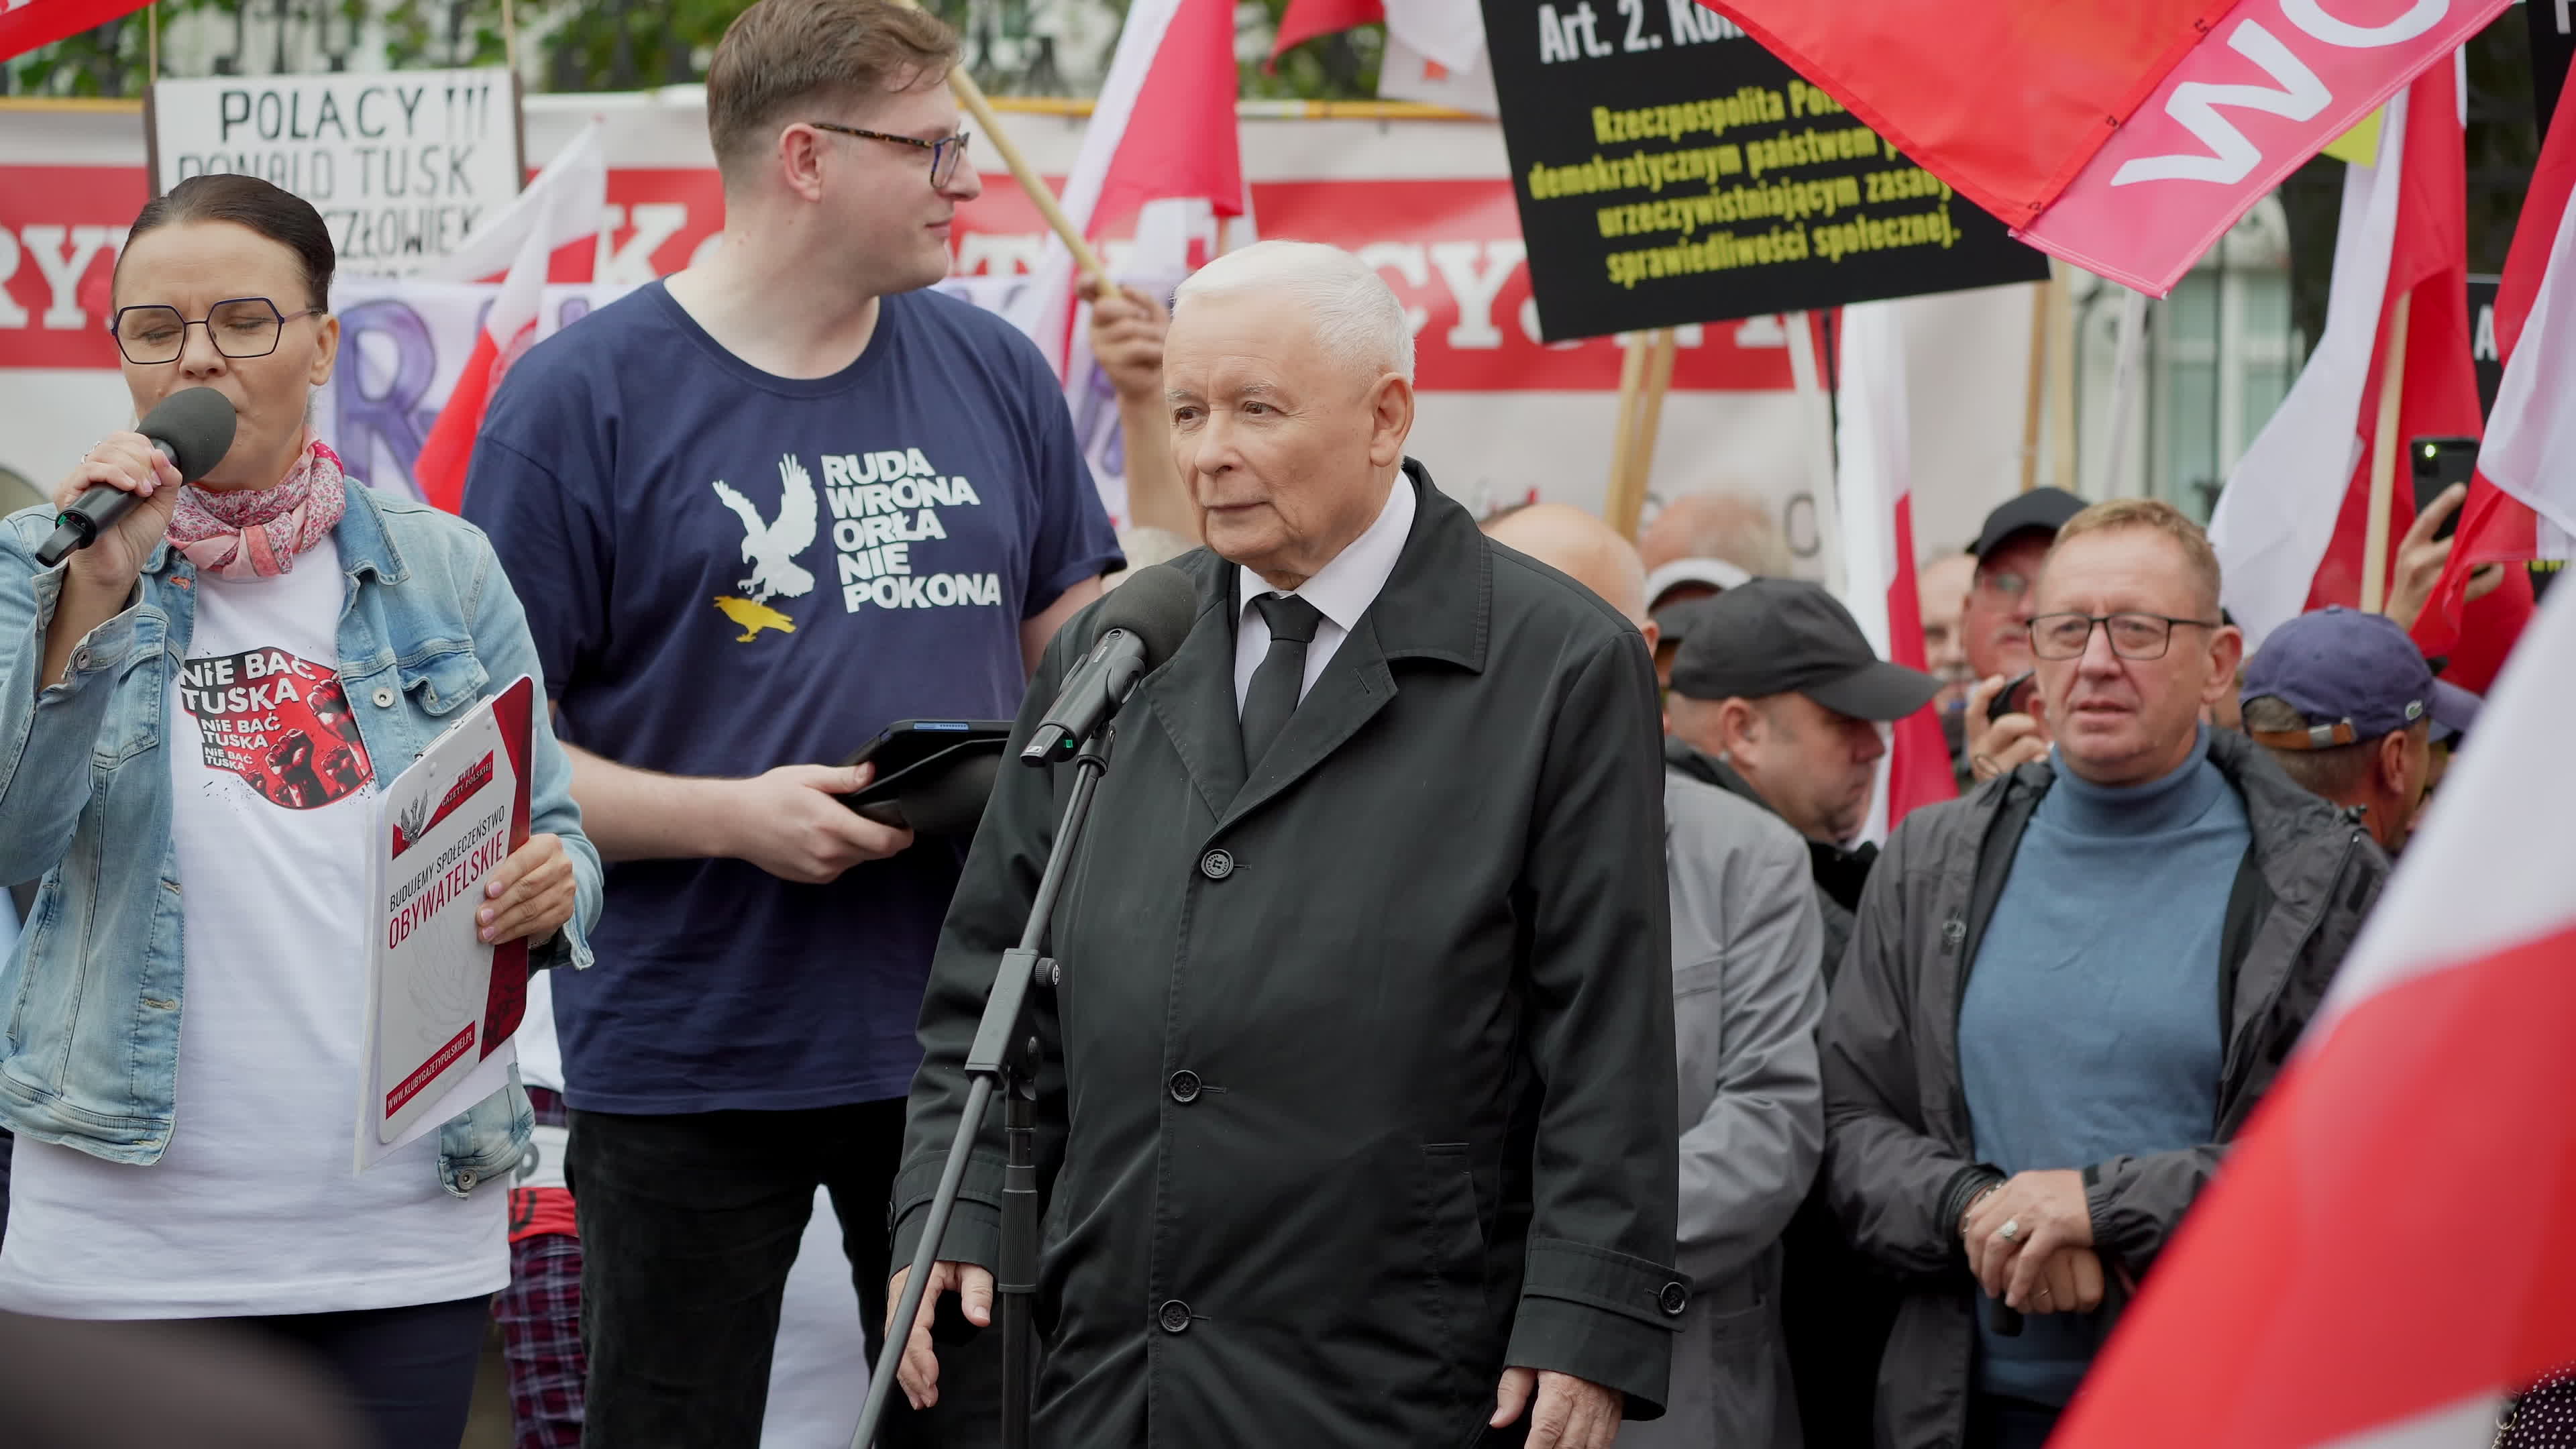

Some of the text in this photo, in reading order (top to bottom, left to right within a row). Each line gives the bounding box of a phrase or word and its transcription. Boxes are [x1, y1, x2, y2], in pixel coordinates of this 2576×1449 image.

[1538, 2, 1613, 64] Art.
[1617, 0, 1663, 53] 2.
[221, 87, 424, 143] POLACY
[1591, 85, 1786, 145] Rzeczpospolita
[353, 145, 475, 197] TUSK
[1527, 143, 1743, 201] demokratycznym
[1746, 125, 1878, 180] państwem
[1597, 174, 1861, 238] urzeczywistniającym
[1606, 221, 1809, 290] sprawiedliwości
[820, 447, 936, 487] RUDA
[825, 476, 981, 519] WRONA
[833, 508, 947, 553] ORŁA
[837, 542, 912, 586] NIE
[842, 573, 1002, 614] POKONA
[244, 651, 317, 681] BAĆ
[180, 678, 301, 714] TUSKA
[203, 731, 269, 751] TUSKA
[237, 712, 282, 733] BAĆ
[205, 755, 246, 771] TUSKA
[441, 761, 492, 807] GAZETY POLSKIEJ
[390, 805, 504, 912] BUDUJEMY SPOŁECZEŃSTWO
[389, 829, 504, 949] OBYWATELSKIE
[387, 1030, 473, 1110] WWW.KLUBYGAZETYPOLSKIEJ.PL
